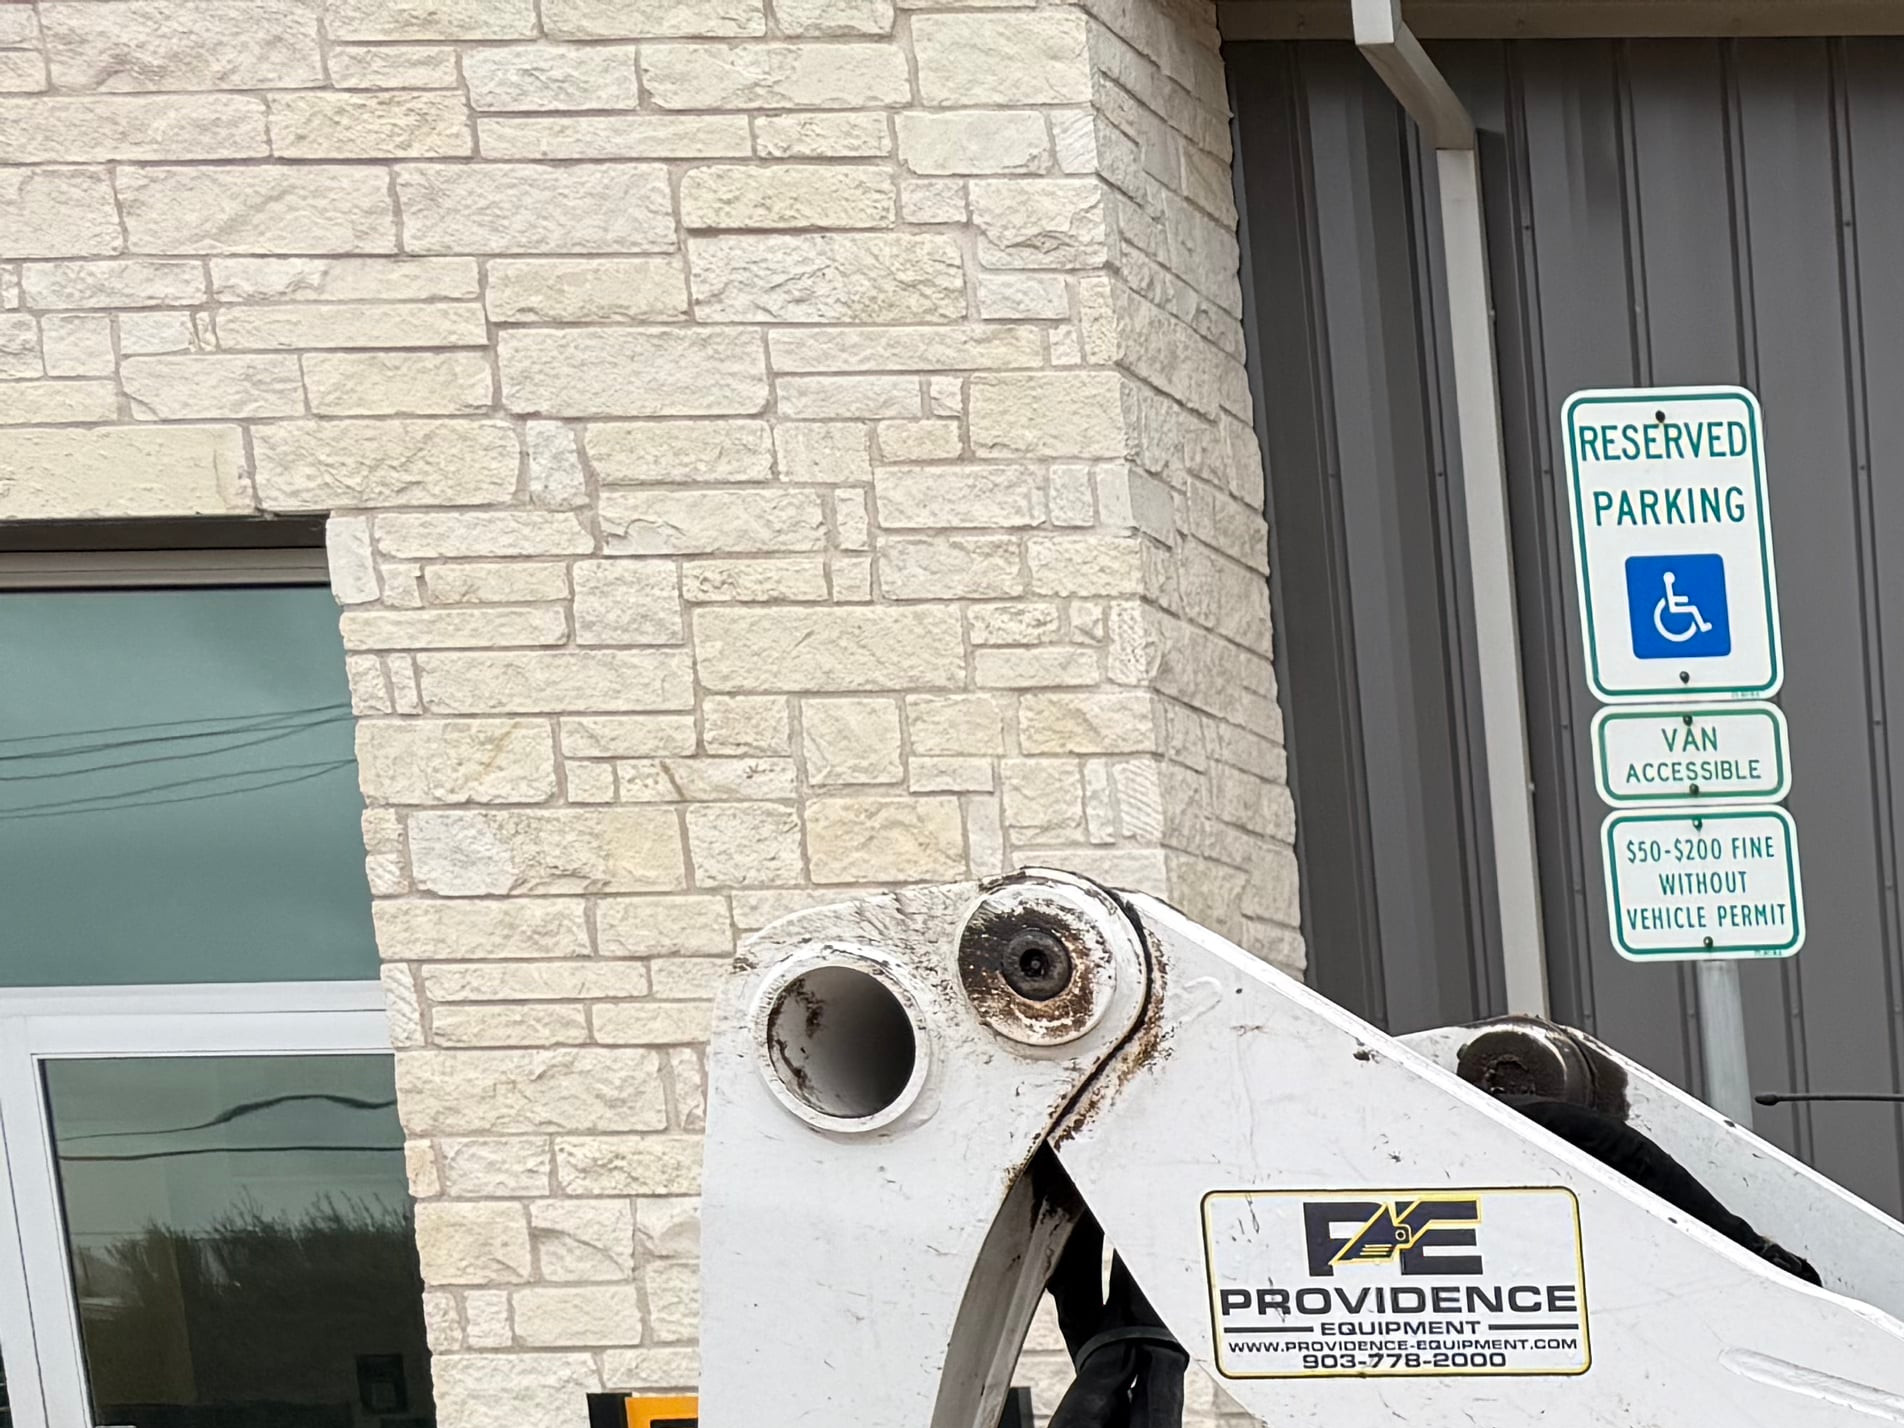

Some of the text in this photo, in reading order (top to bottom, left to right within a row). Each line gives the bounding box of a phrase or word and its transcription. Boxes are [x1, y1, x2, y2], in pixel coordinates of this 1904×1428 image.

[1579, 421, 1749, 461] RESERVED
[1593, 486, 1746, 527] PARKING
[1661, 727, 1718, 753] VAN
[1625, 760, 1762, 784] ACCESSIBLE
[1626, 836, 1775, 863] $50-$200 FINE
[1659, 871, 1748, 897] WITHOUT
[1626, 902, 1787, 932] VEHICLE PERMIT
[1220, 1285, 1578, 1316] PROVIDENCE
[1320, 1321, 1481, 1336] EQUIPMENT
[1228, 1339, 1578, 1353] WWW.PROVIDENCE-EQUIPMENT.COM
[1303, 1352, 1506, 1369] 903-778-2000
